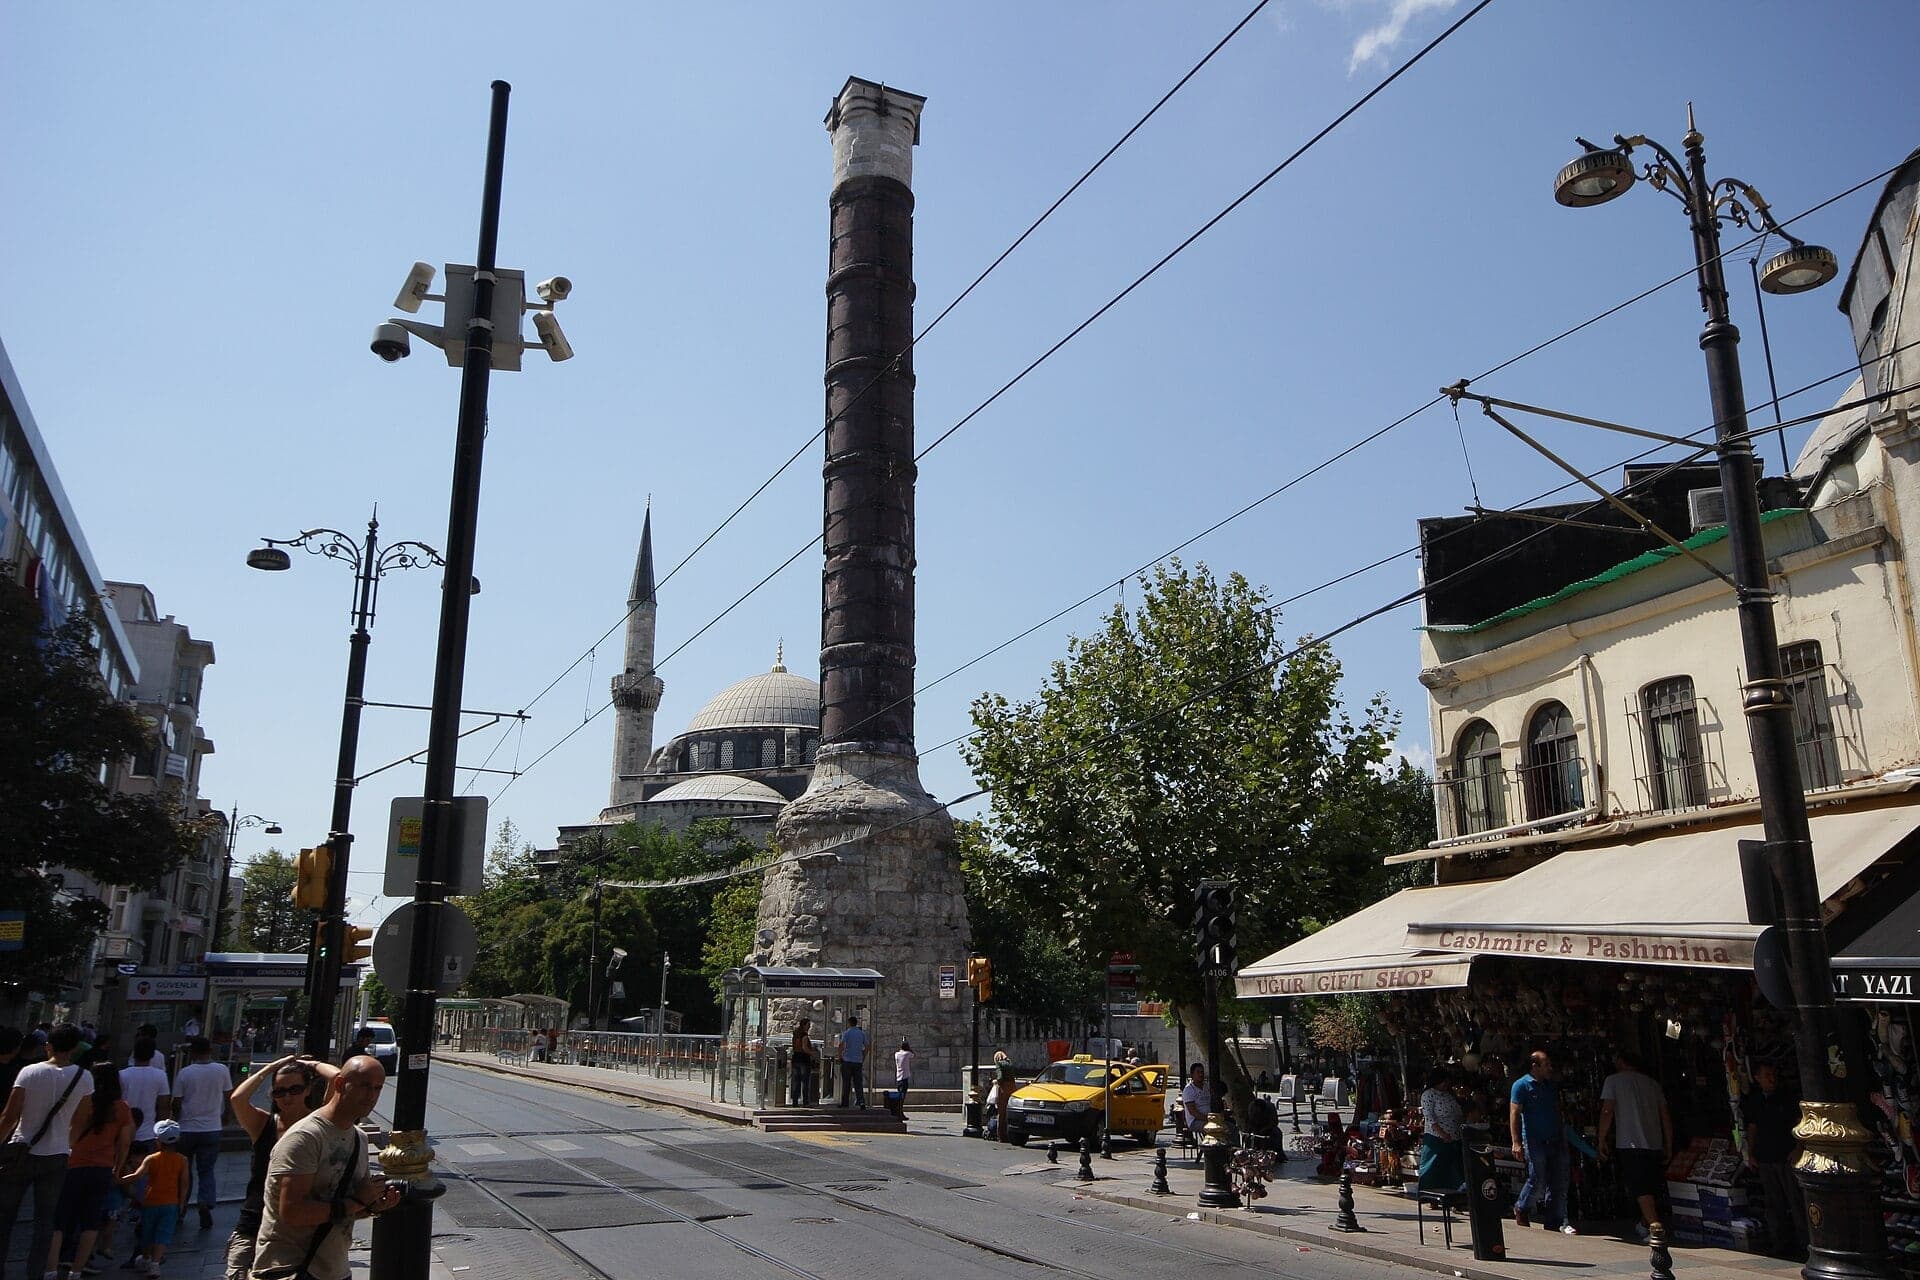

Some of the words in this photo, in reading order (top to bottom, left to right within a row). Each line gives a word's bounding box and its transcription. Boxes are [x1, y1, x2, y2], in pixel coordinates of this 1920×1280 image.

[1439, 931, 1548, 953] Cashmire
[1559, 936, 1573, 954] &
[1586, 936, 1731, 963] Pashmina
[1208, 969, 1228, 977] 4106
[1376, 969, 1433, 987] SHOP
[1860, 975, 1913, 996] YAZI
